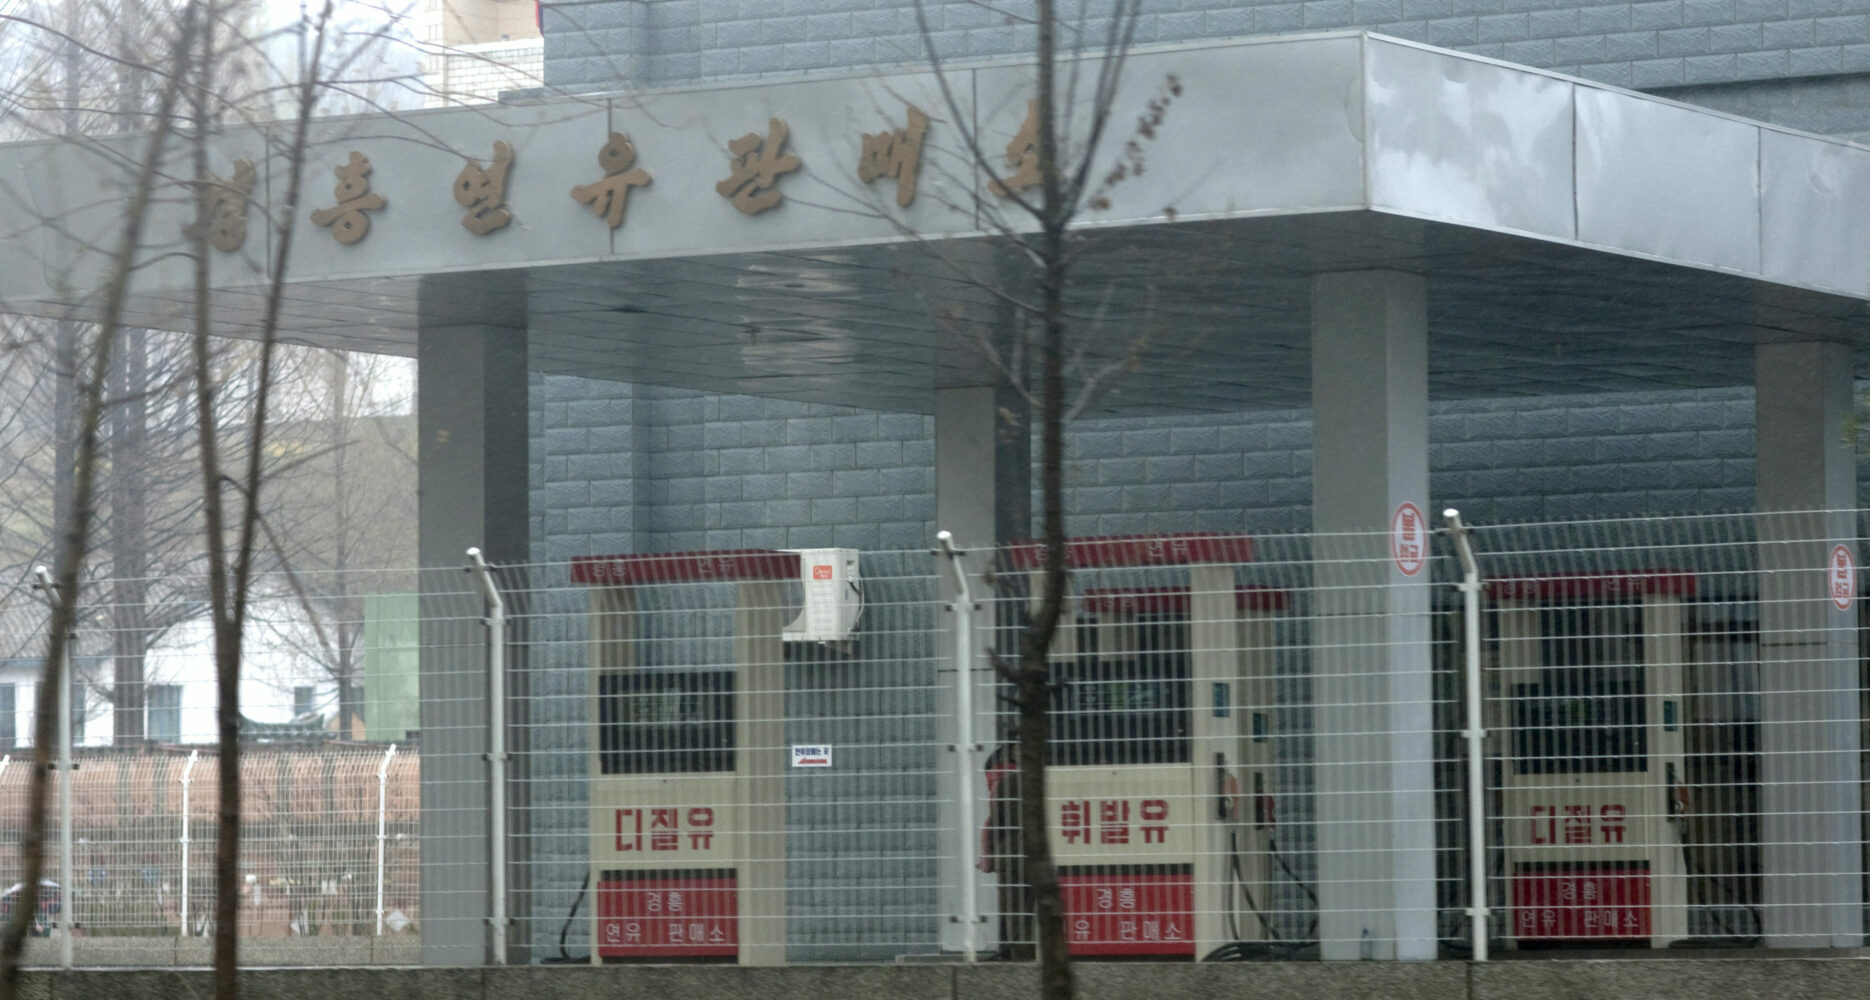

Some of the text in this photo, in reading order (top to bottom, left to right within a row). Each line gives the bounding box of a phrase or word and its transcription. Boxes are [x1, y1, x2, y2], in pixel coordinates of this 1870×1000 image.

[615, 807, 715, 852] 디젤유
[1061, 799, 1169, 844] 휘발유
[1530, 804, 1626, 845] 디젤유
[647, 891, 683, 912] 경흥
[1096, 887, 1137, 909] 경흥
[1521, 909, 1639, 928] 연유 판매소
[606, 922, 724, 943] 연유 판매소
[1120, 920, 1182, 941] 판매소
